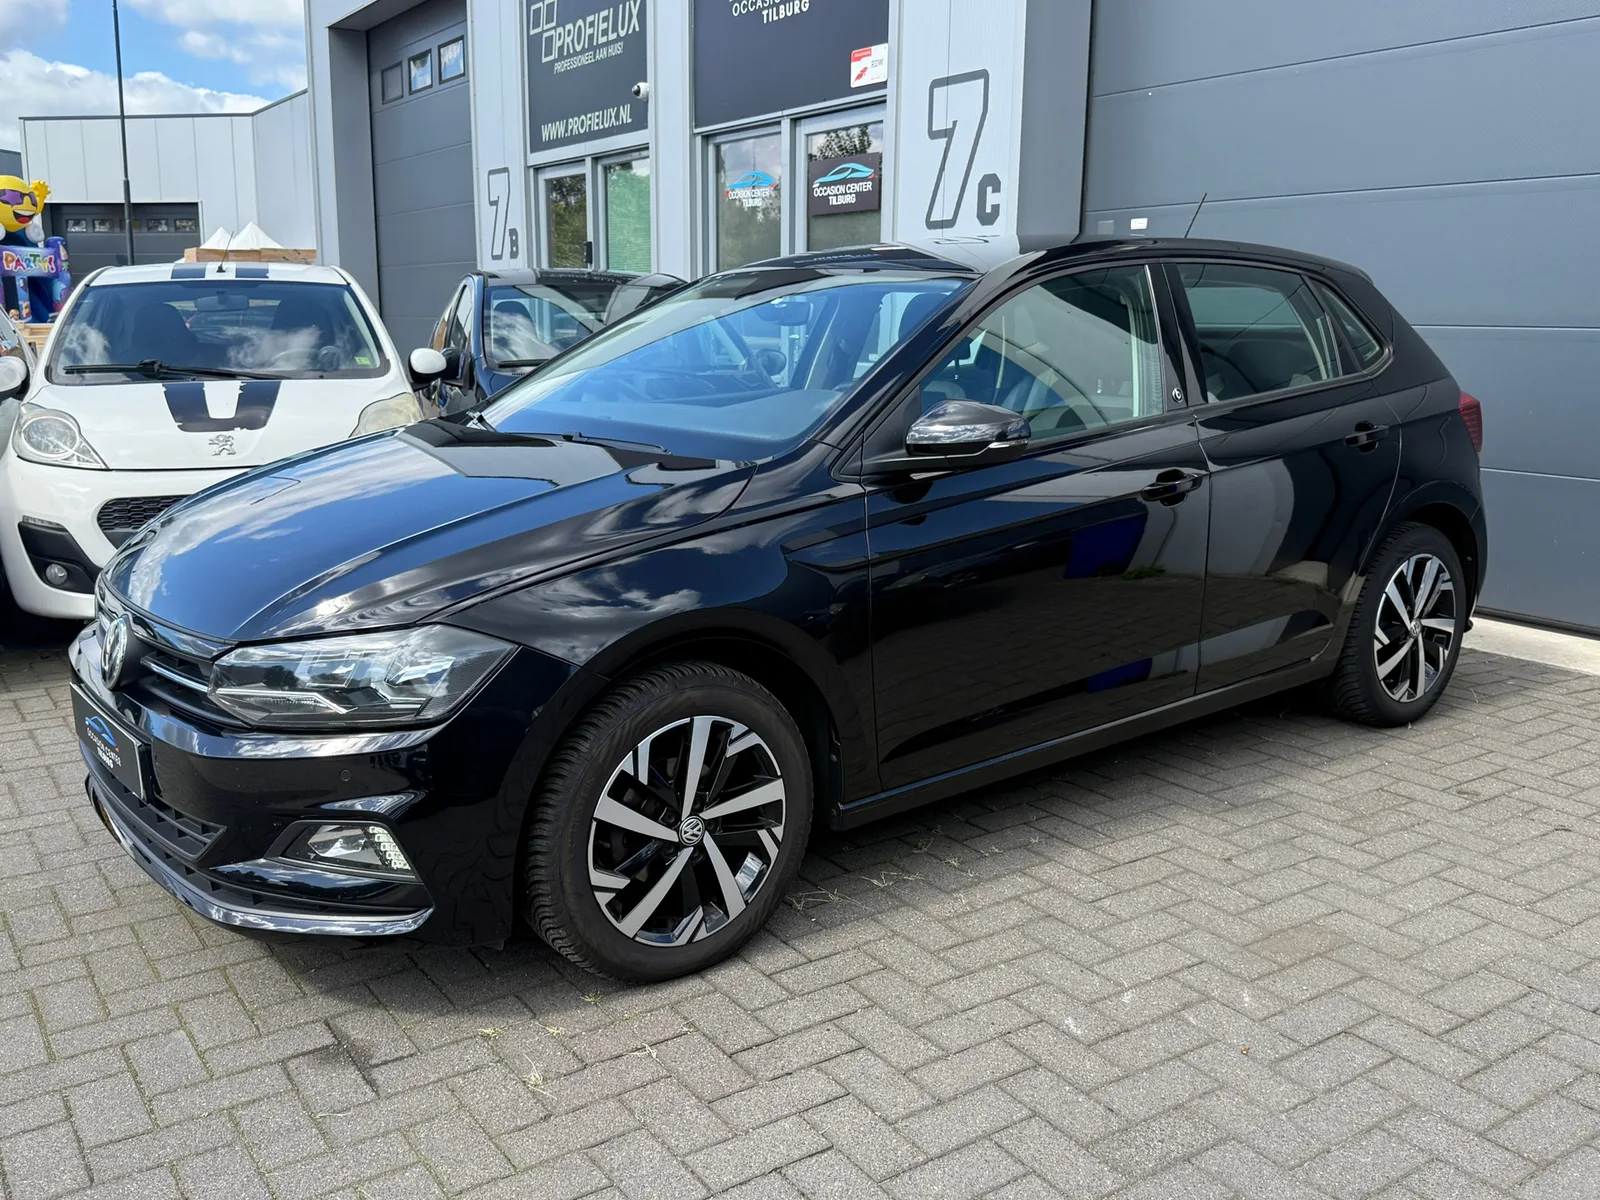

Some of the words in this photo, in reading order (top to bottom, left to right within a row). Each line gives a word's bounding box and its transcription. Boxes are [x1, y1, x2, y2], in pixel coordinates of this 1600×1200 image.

[761, 0, 810, 24] TILBURG
[554, 0, 641, 59] PROFIELUX
[553, 50, 596, 75] PROFESSIONEEL
[595, 46, 608, 62] AAN
[608, 41, 624, 57] HUIS!
[541, 103, 633, 142] WWW.PROFIELUX.NL
[813, 184, 846, 197] OCCASION
[846, 181, 873, 193] CENTER
[828, 194, 856, 206] TILBURG
[2, 251, 57, 273] PARTY!
